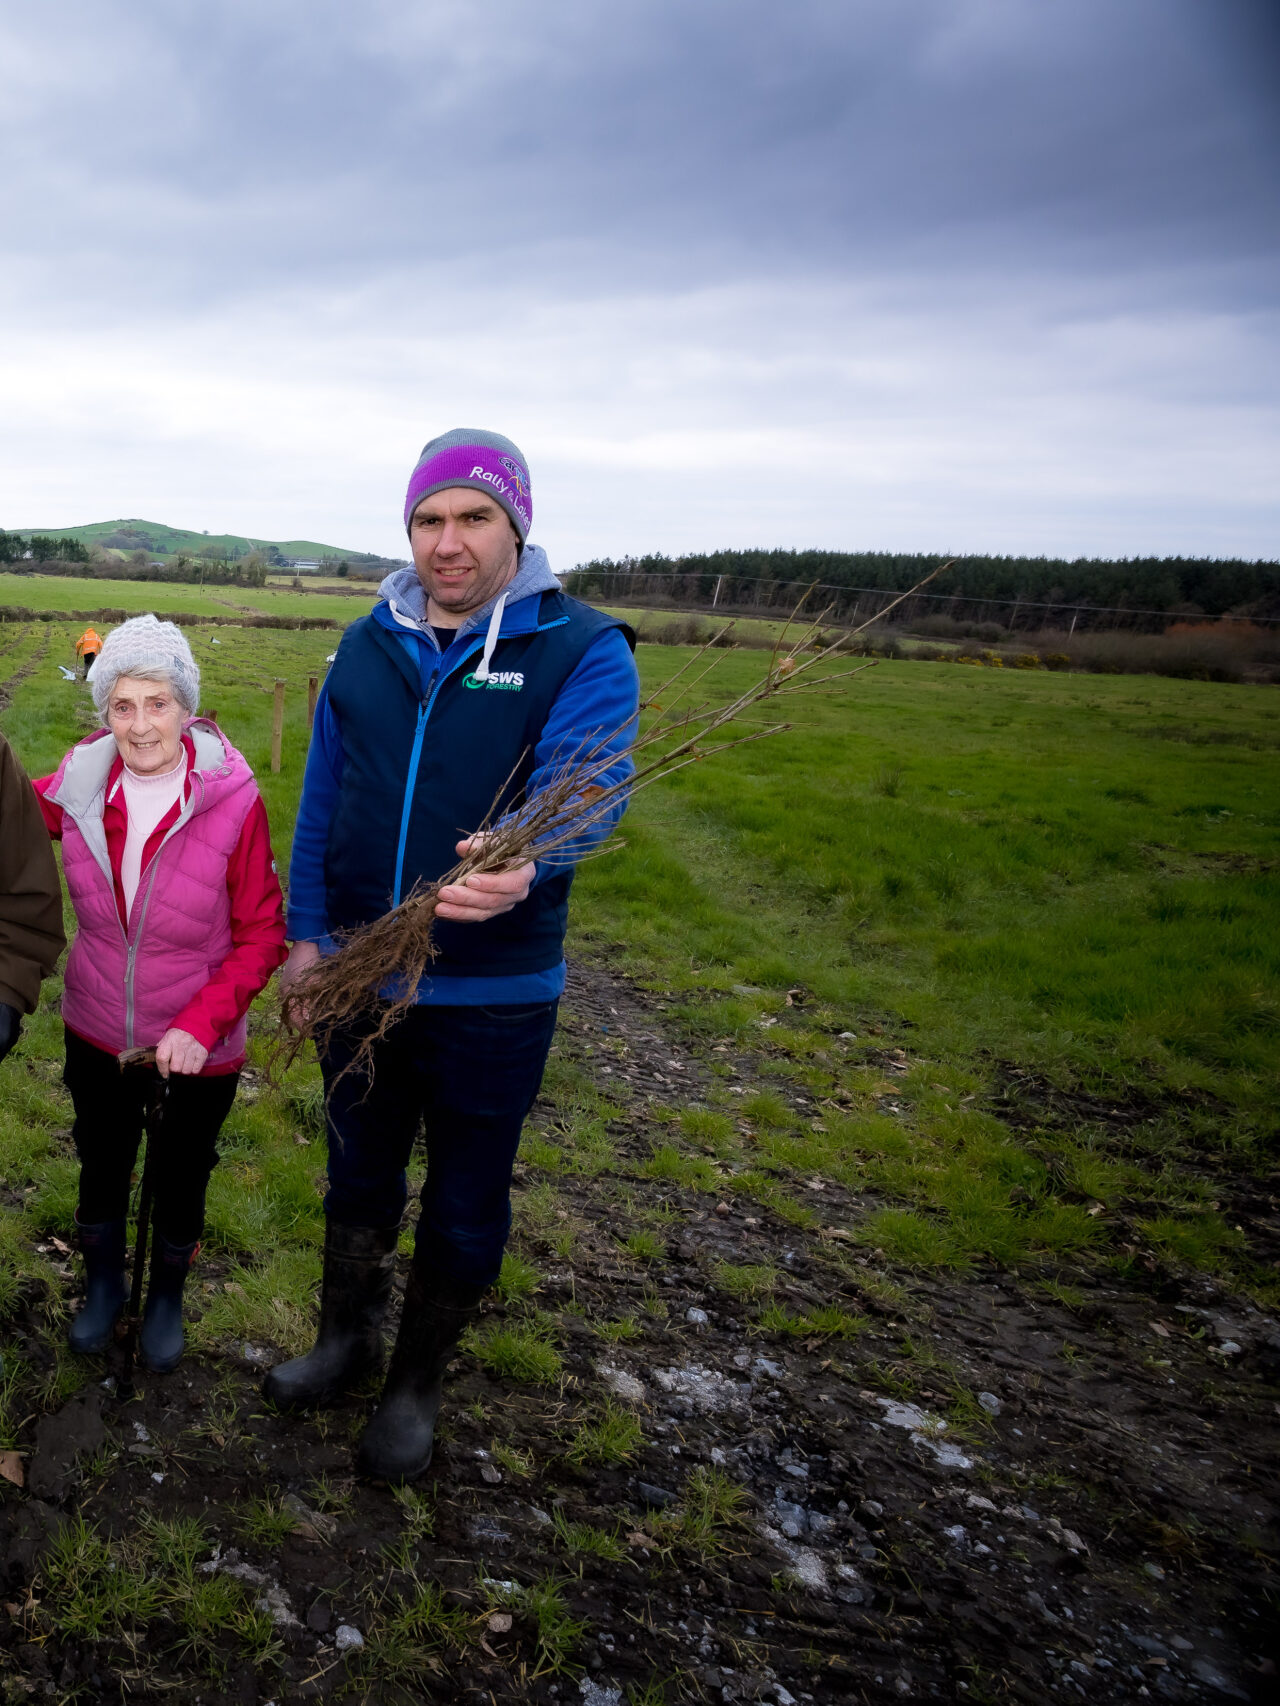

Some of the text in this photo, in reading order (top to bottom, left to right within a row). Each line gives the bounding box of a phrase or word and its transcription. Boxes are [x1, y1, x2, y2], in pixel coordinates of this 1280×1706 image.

[469, 466, 509, 493] Rally
[488, 672, 524, 686] SWS
[486, 684, 522, 692] FORESTRY
